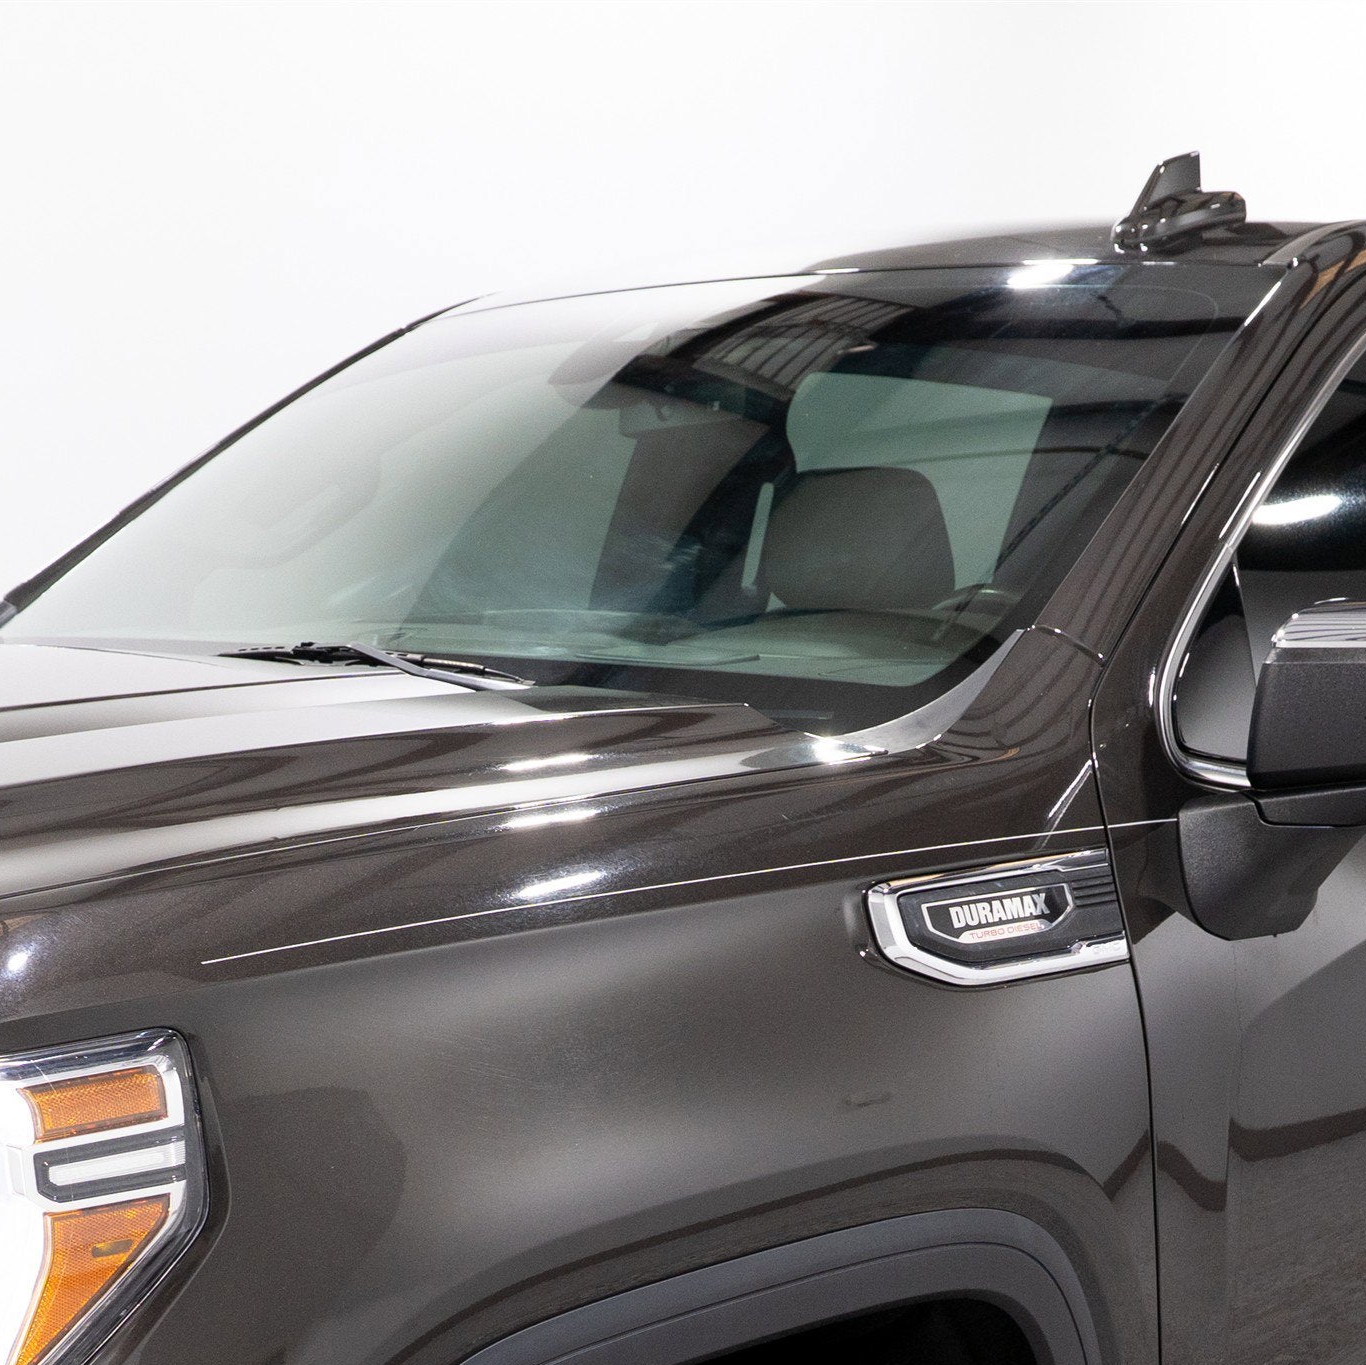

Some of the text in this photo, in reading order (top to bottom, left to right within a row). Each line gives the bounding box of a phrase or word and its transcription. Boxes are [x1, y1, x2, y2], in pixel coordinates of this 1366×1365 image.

[948, 893, 1050, 929] DURAMAX
[970, 921, 1043, 940] TURBO DIESEL
